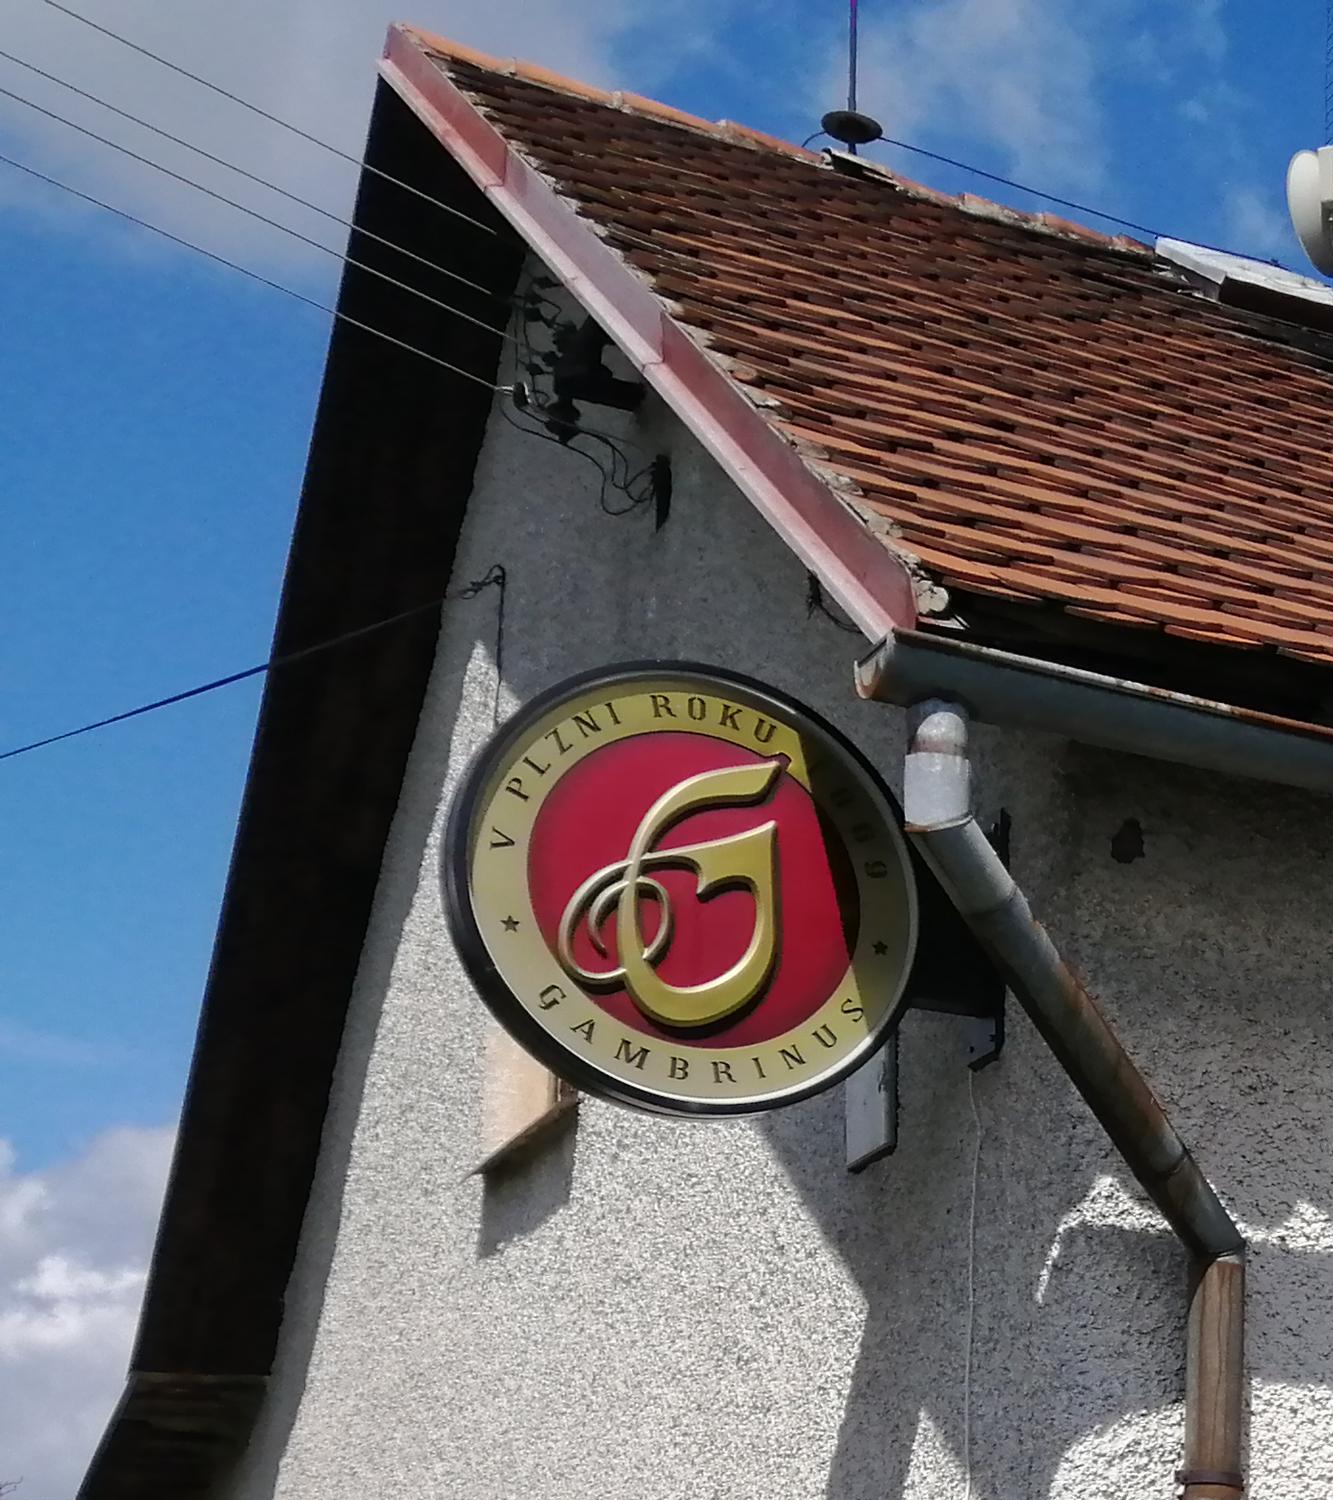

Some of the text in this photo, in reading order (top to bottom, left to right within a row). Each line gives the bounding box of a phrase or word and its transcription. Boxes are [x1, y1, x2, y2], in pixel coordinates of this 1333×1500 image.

[489, 827, 515, 851] V
[505, 702, 622, 802] PLZNI
[649, 694, 777, 744] ROKU
[538, 984, 865, 1084] GAMBRINUS
